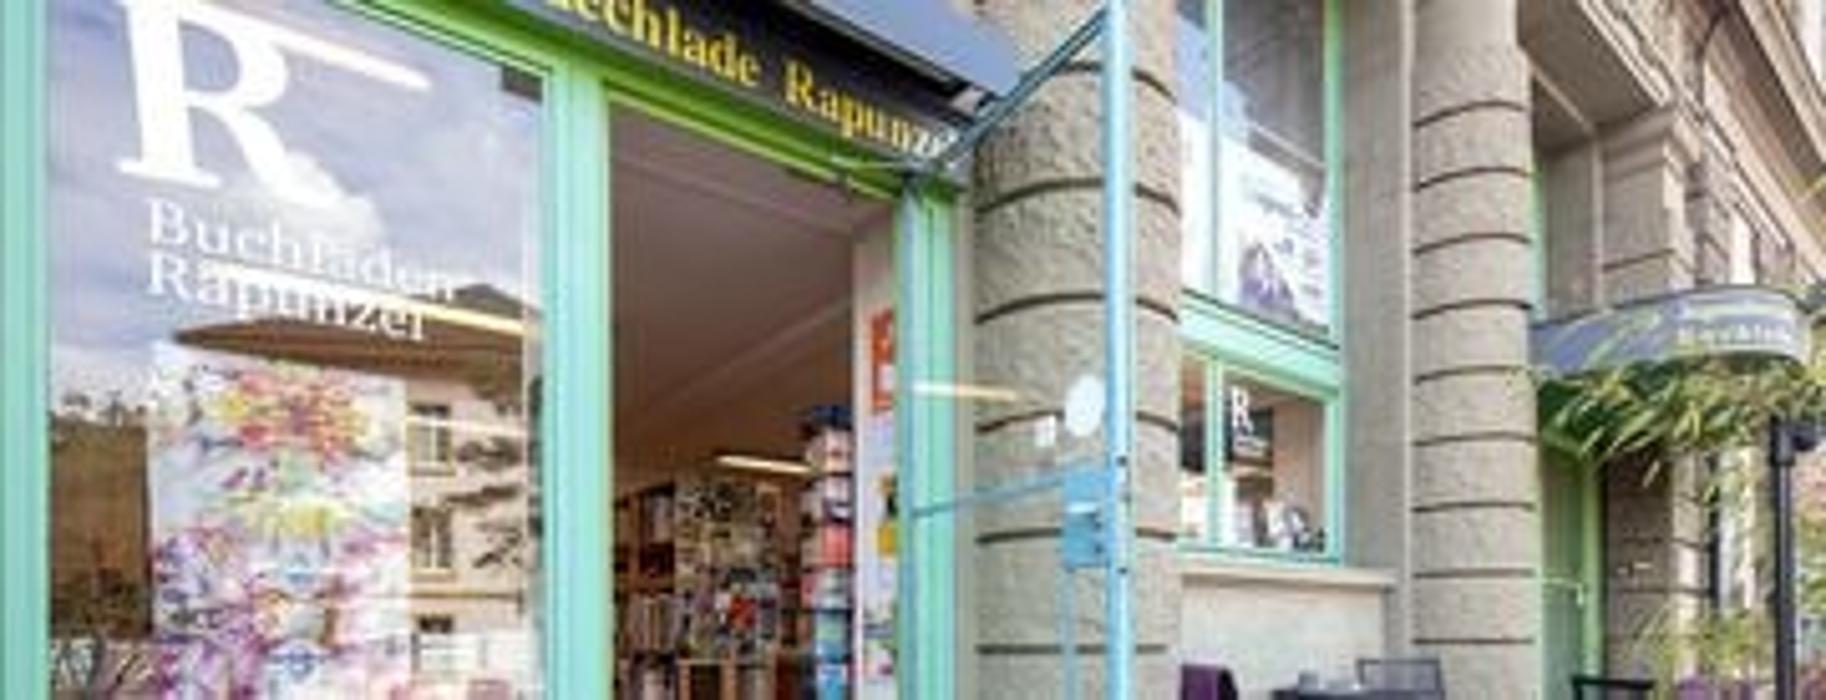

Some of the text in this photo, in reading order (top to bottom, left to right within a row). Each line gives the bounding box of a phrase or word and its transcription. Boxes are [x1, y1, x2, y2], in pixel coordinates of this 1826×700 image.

[118, 0, 345, 202] R
[148, 251, 425, 341] Rapunzel
[149, 198, 454, 300] Buchladen
